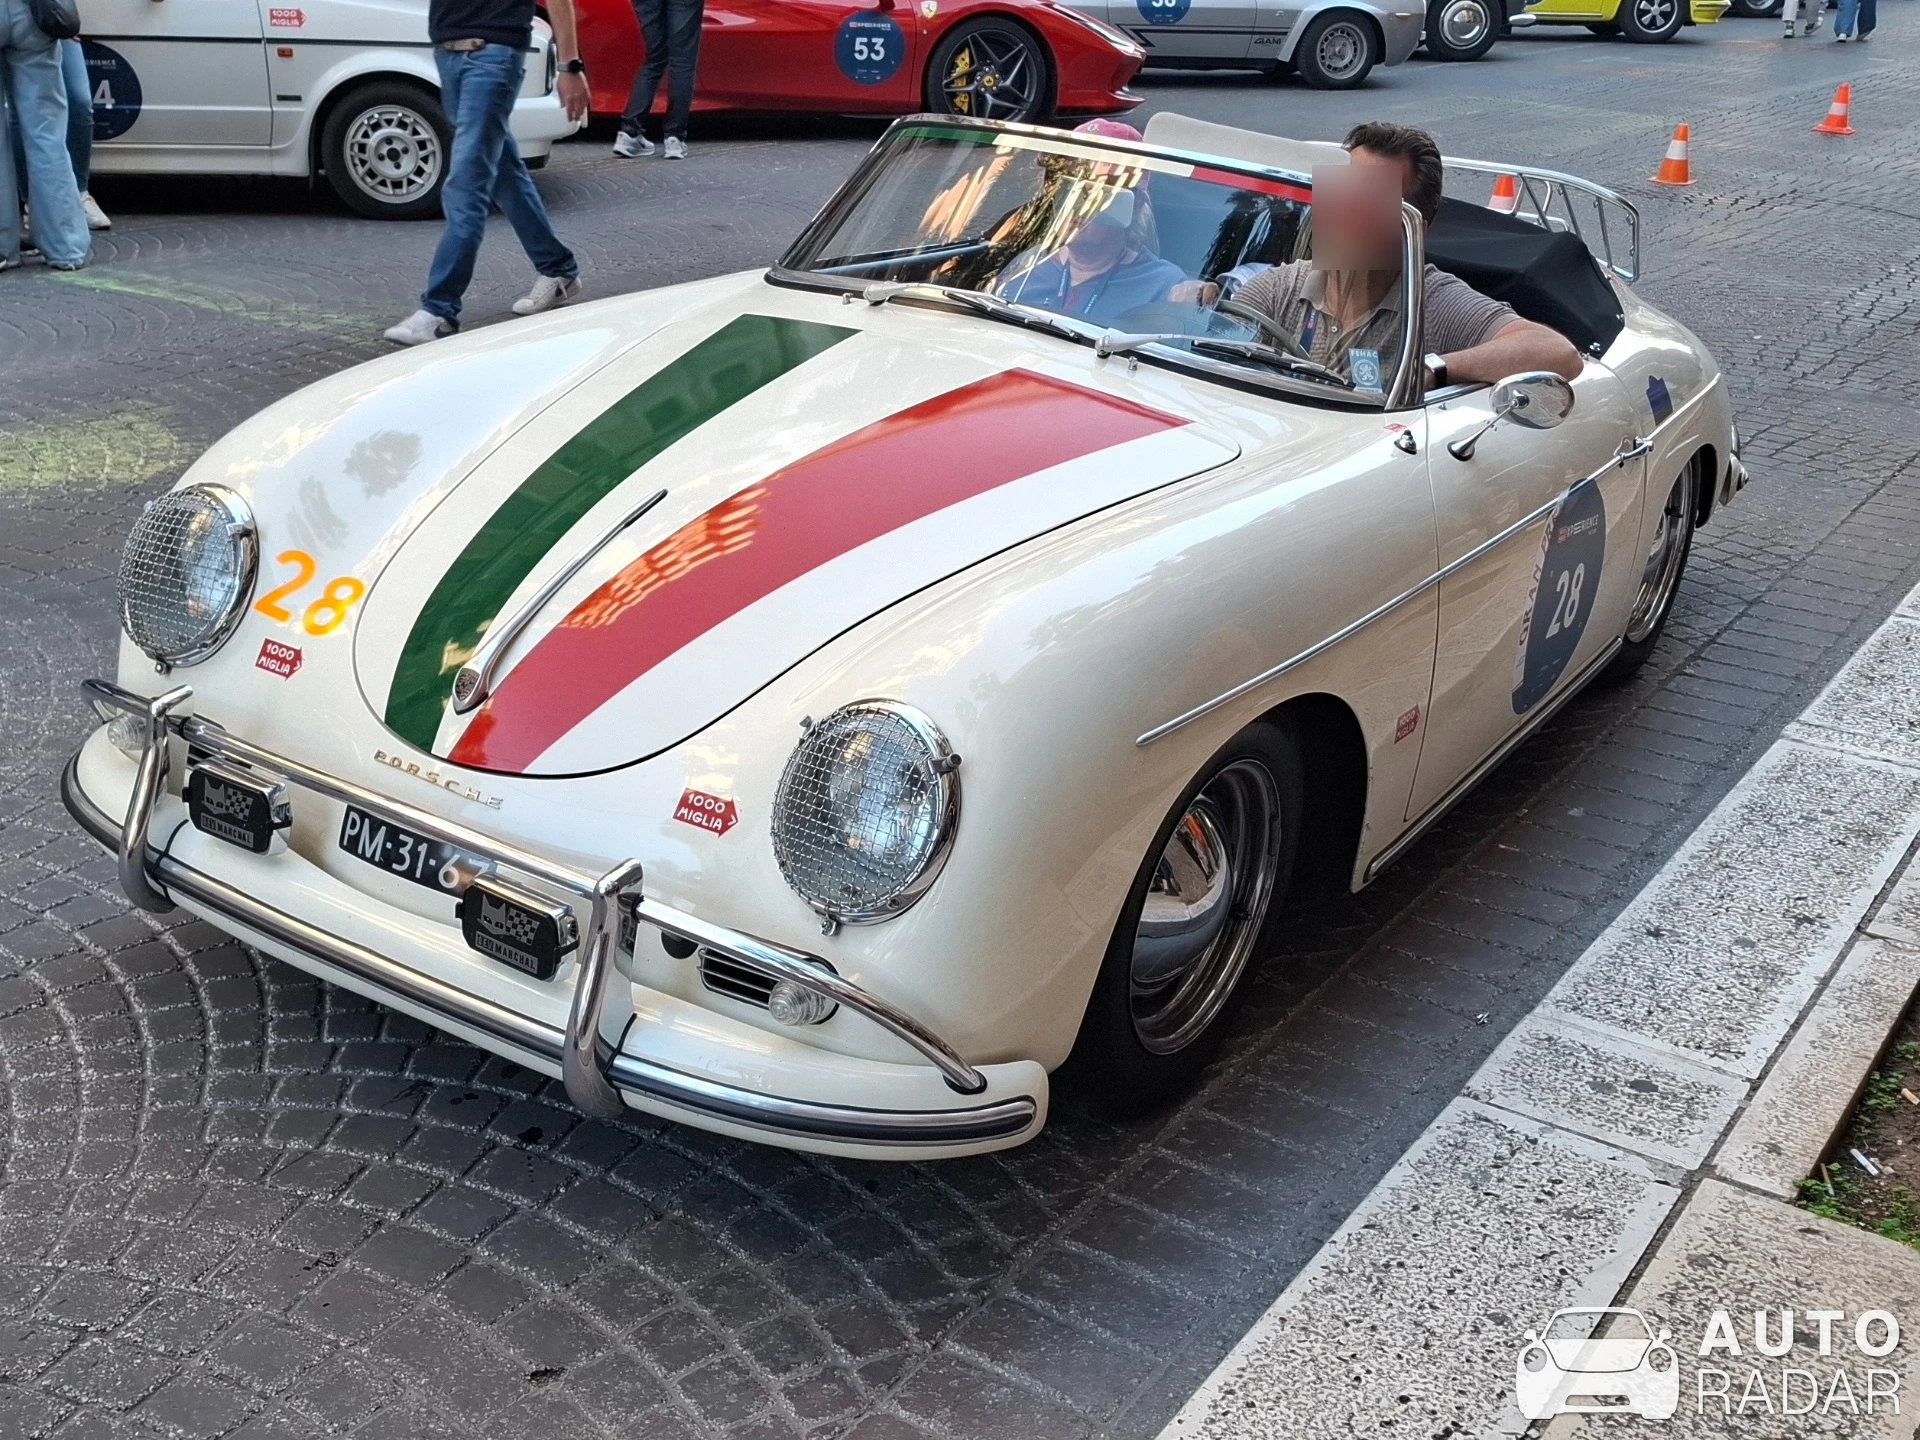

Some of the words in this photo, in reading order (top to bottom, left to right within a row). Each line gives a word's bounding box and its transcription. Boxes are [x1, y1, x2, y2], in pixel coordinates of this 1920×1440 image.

[853, 37, 885, 61] 53
[93, 80, 116, 109] 4
[1350, 350, 1378, 358] FEHAC
[252, 549, 365, 637] 28
[1545, 562, 1585, 639] 28
[266, 643, 295, 661] 1000
[258, 655, 291, 675] MIGLIA
[374, 749, 504, 810] PORSCHE
[687, 793, 726, 814] 1000
[676, 806, 722, 831] MIGLIA
[217, 821, 252, 845] MARCHAL
[495, 943, 536, 970] MARCHAL
